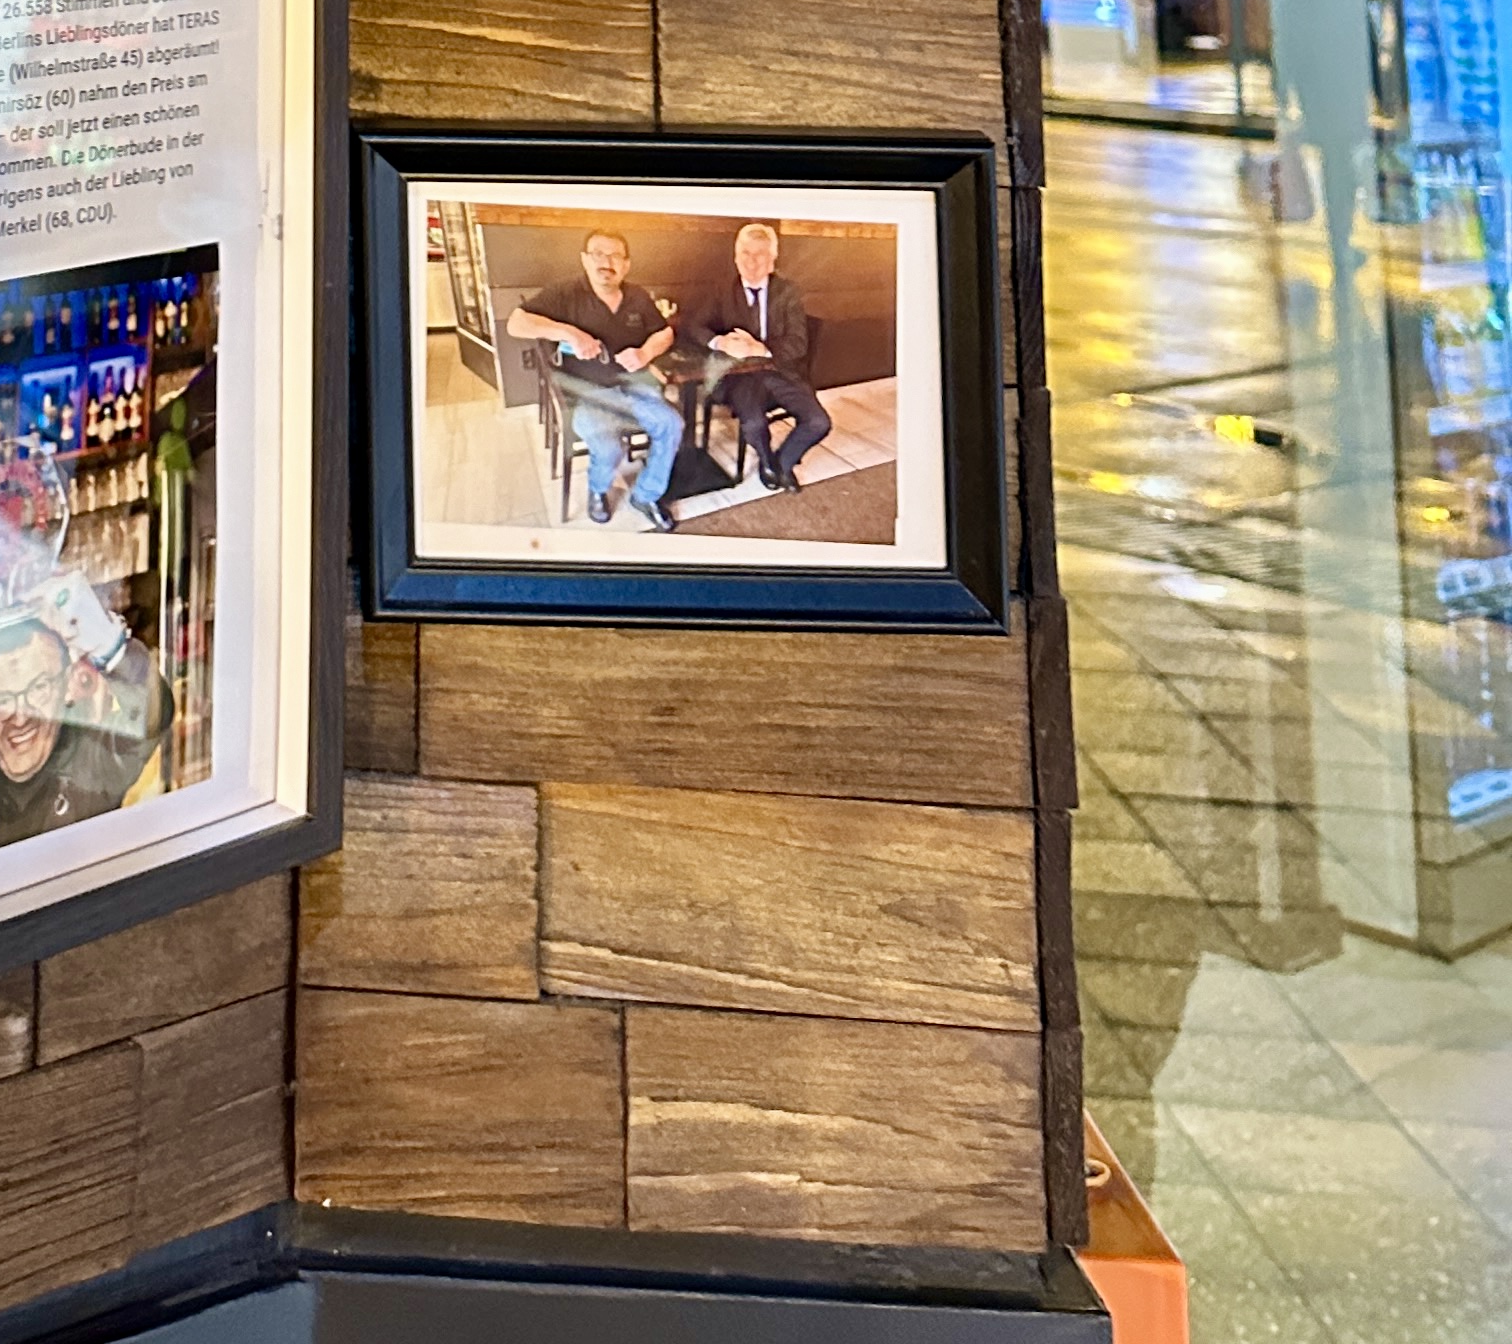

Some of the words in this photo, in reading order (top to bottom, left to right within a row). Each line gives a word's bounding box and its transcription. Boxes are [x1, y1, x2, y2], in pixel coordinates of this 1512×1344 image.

[45, 20, 149, 46] Lieblingsdöner
[152, 16, 175, 33] hat
[177, 9, 220, 30] TERAS
[9, 52, 117, 85] (Wilhelmstraße
[120, 48, 144, 69] 45)
[46, 87, 76, 112] (60)
[79, 84, 118, 103] nahm
[121, 80, 147, 97] den
[150, 77, 184, 93] Preis
[187, 73, 208, 88] am
[10, 125, 33, 143] der
[37, 119, 64, 139] soll
[66, 116, 99, 139] jetzt
[102, 112, 140, 130] einen
[143, 104, 200, 124] schönen
[61, 149, 85, 167] Die
[88, 136, 164, 162] Dönerbude
[166, 134, 179, 150] in
[182, 131, 205, 148] der
[46, 177, 82, 198] auch
[85, 174, 109, 192] der
[112, 166, 165, 188] Liebling
[169, 163, 194, 179] von
